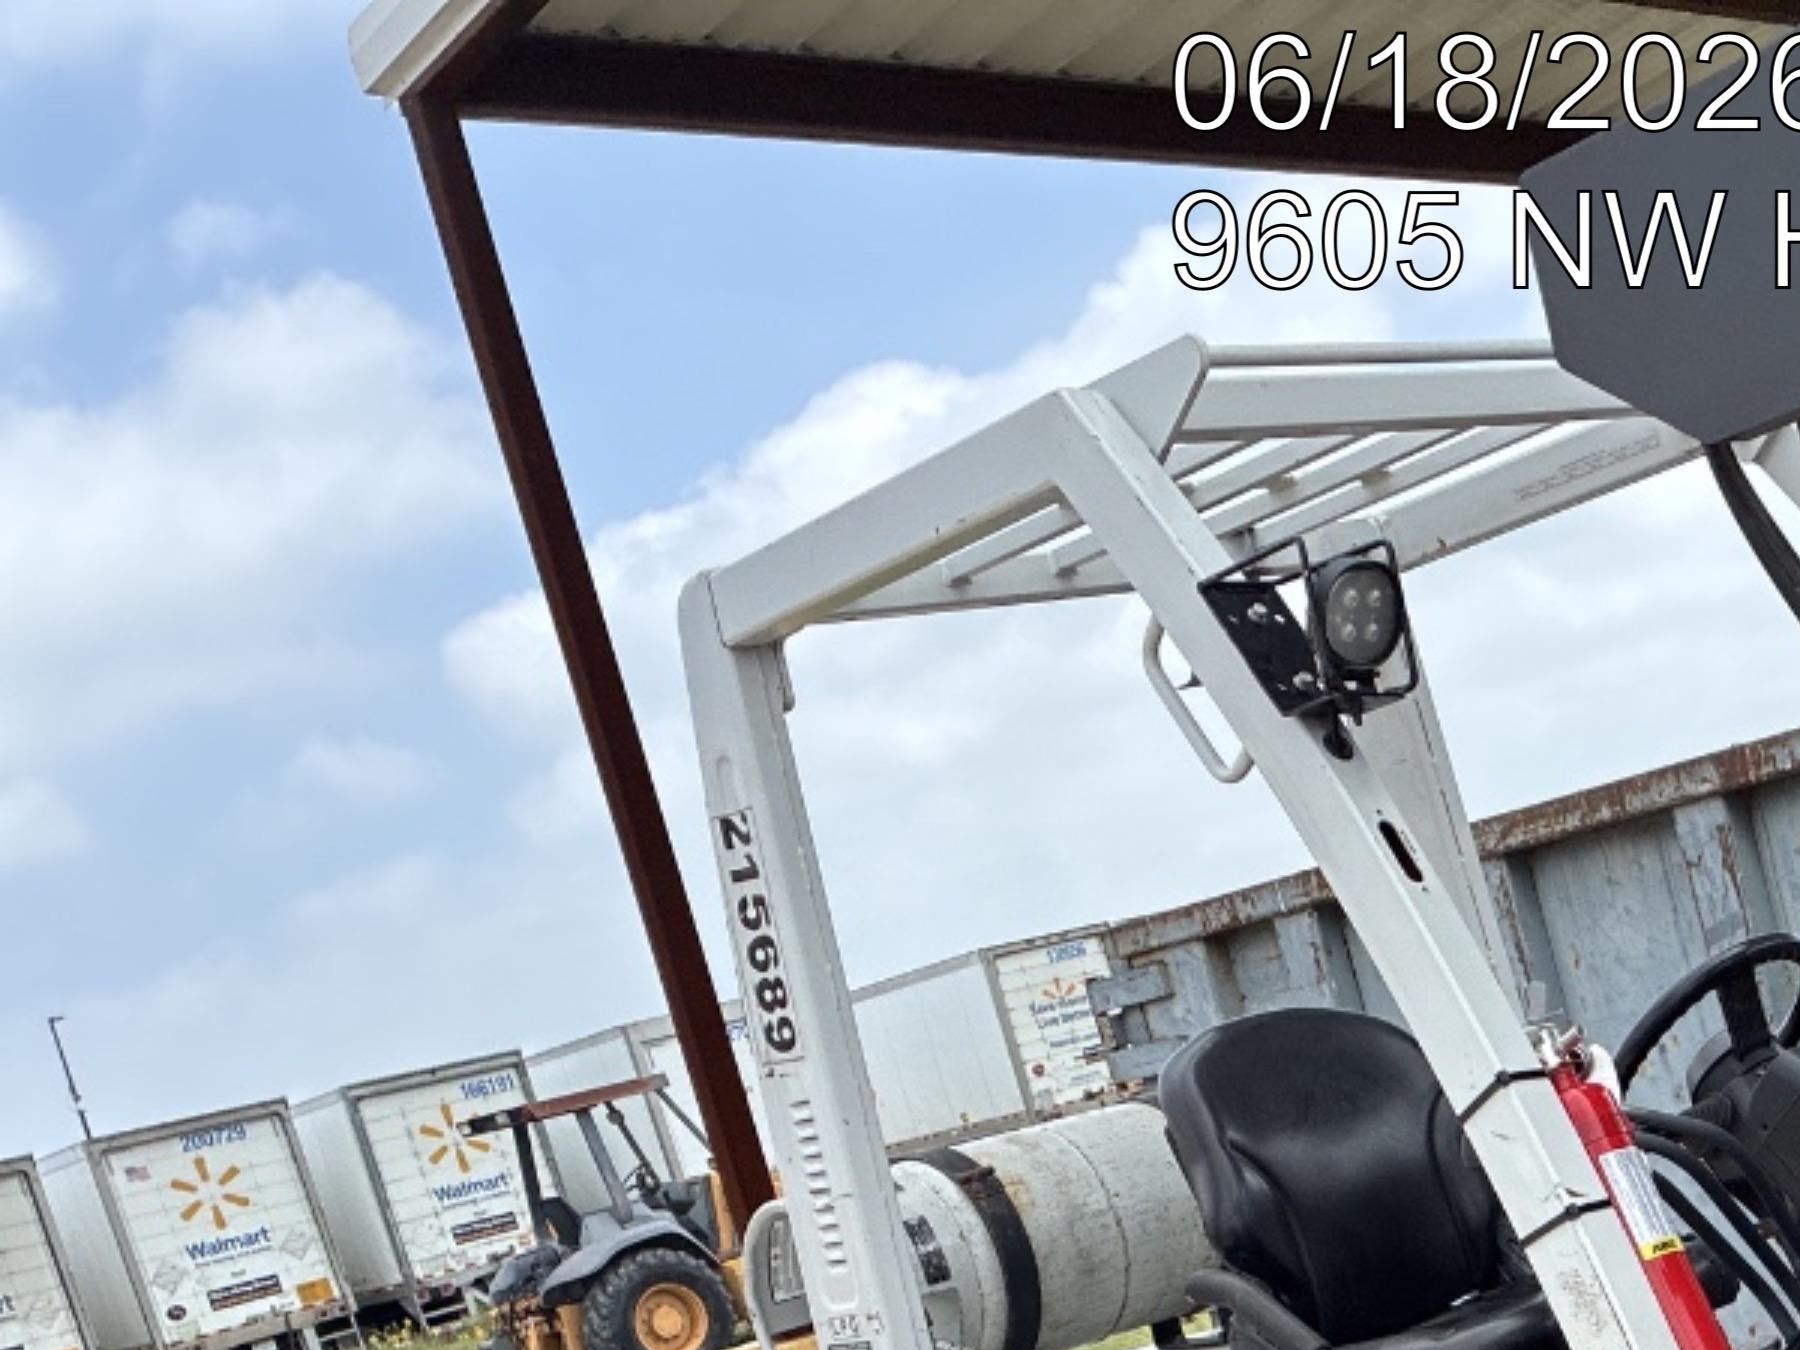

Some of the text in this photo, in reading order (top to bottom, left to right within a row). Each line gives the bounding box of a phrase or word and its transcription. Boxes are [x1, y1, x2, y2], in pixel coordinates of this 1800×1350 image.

[718, 812, 798, 1054] 215689
[433, 1171, 509, 1201] Walmart
[185, 1226, 273, 1261] Walmart
